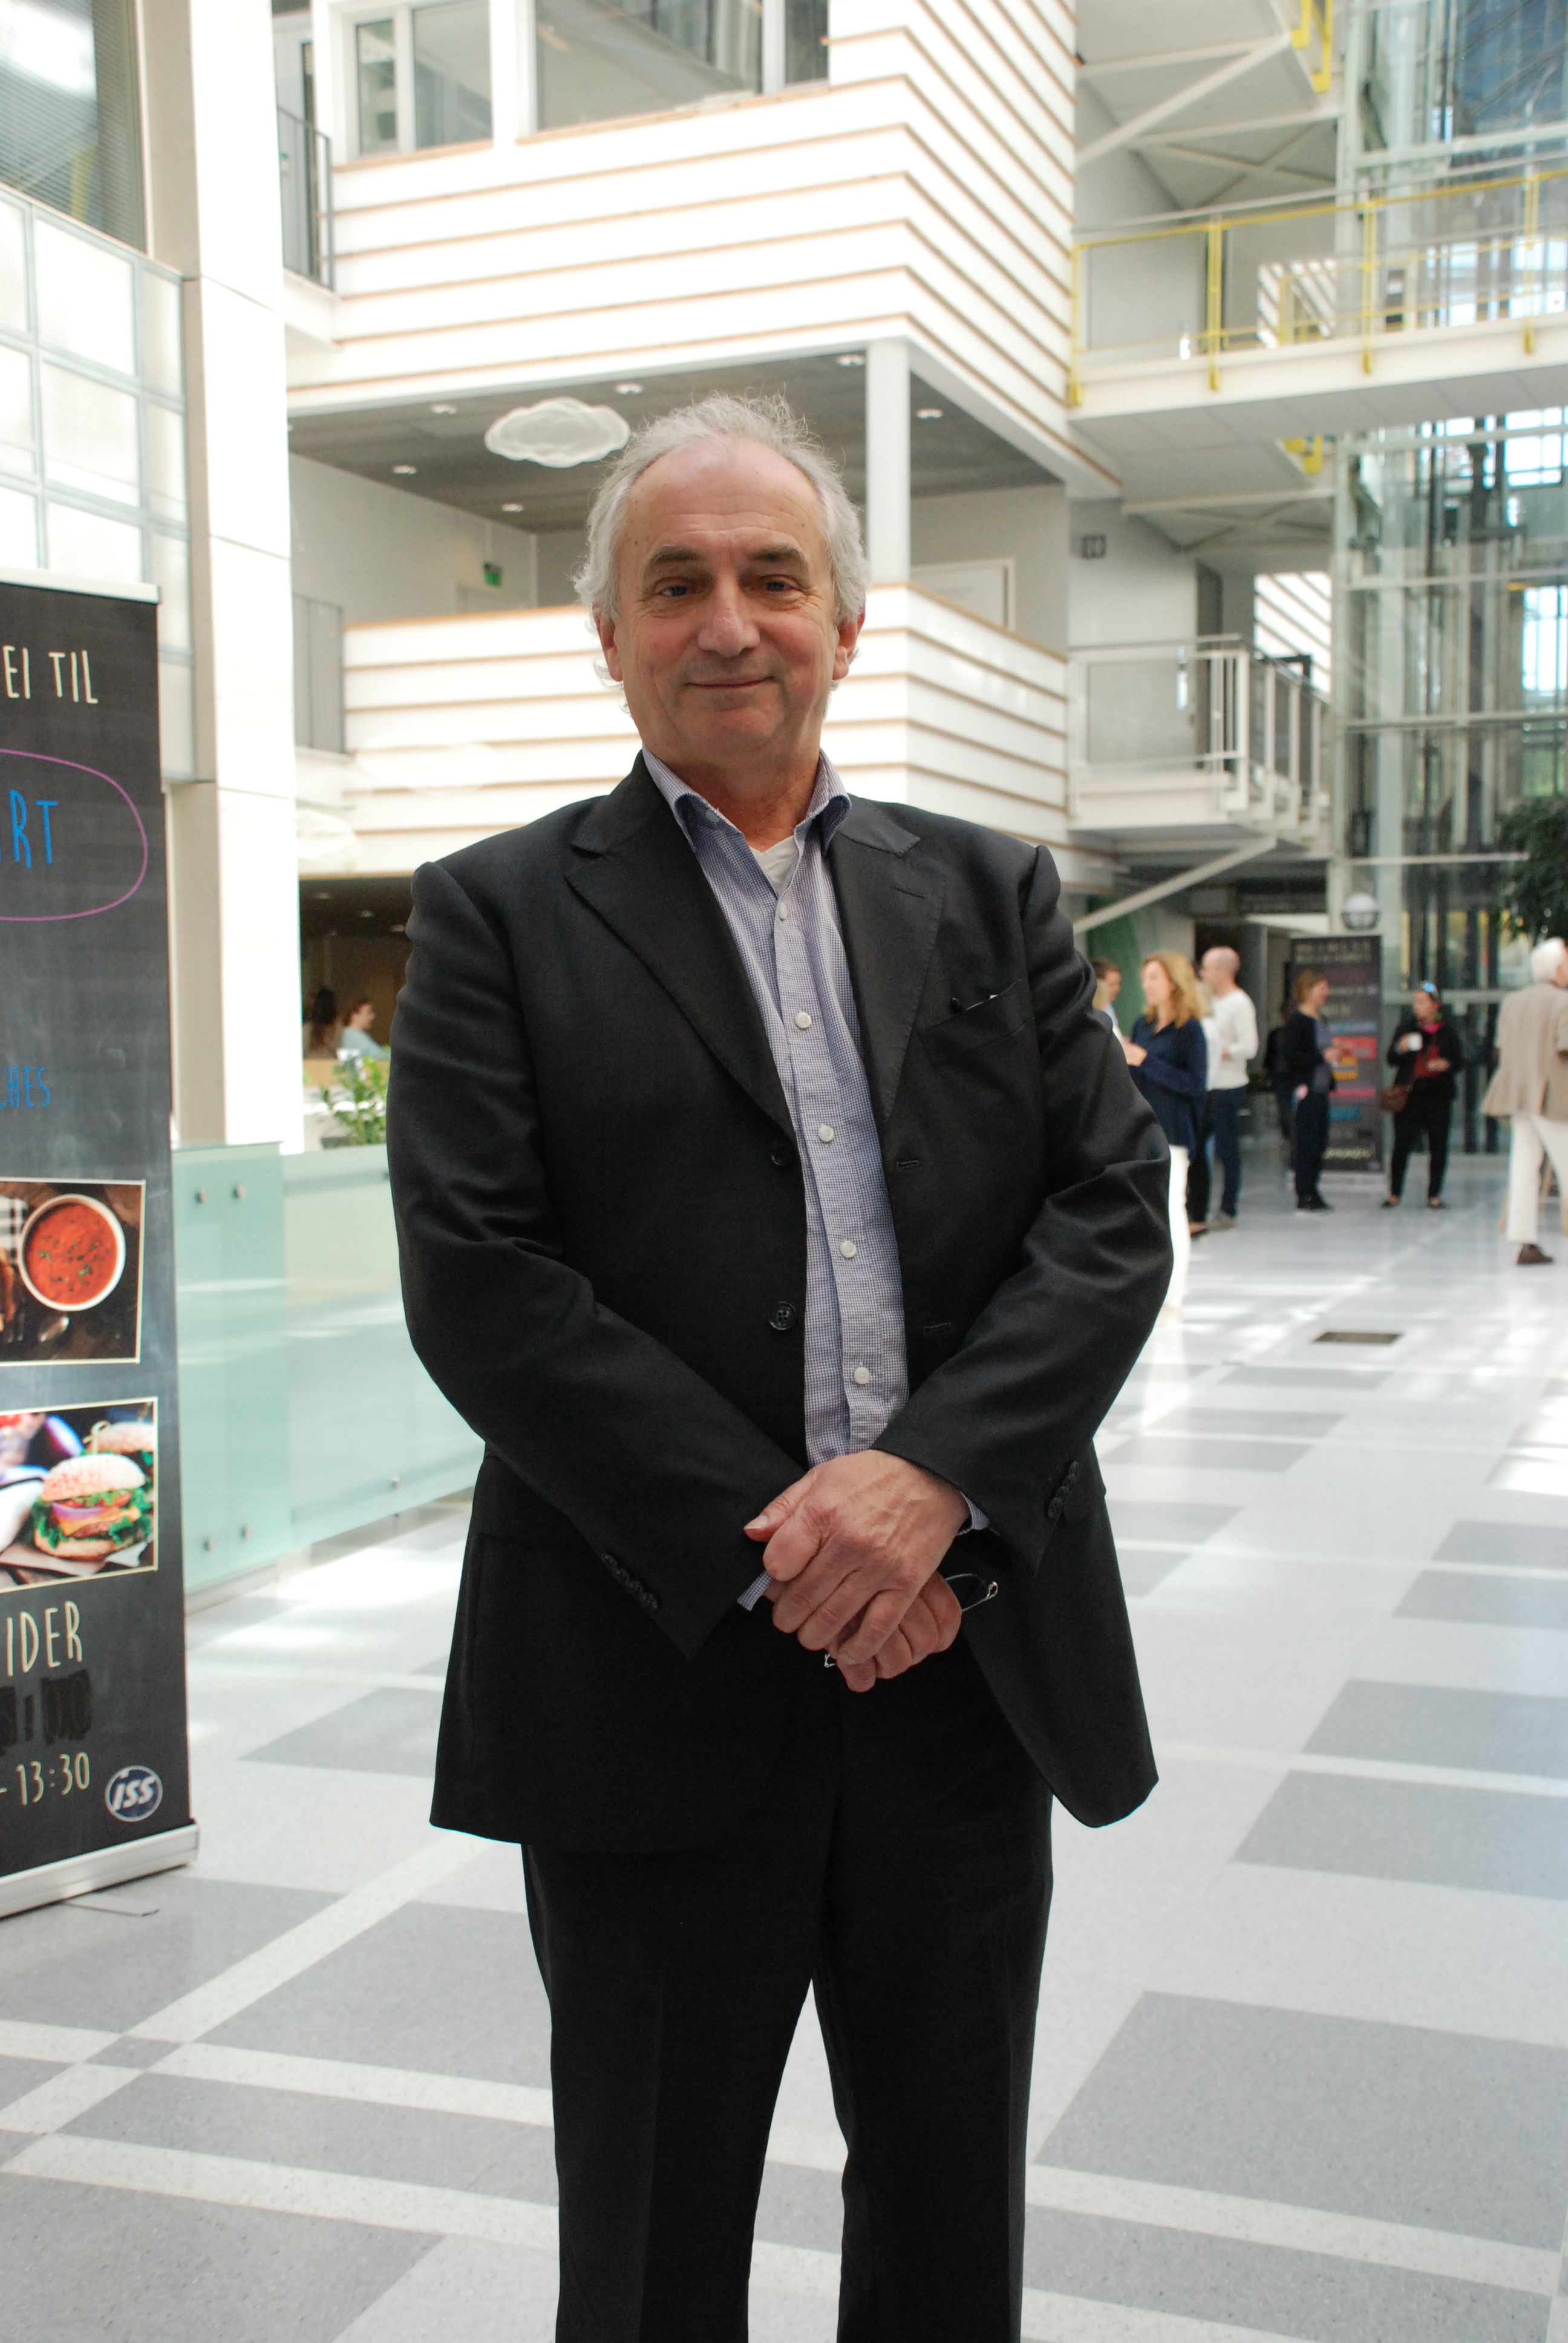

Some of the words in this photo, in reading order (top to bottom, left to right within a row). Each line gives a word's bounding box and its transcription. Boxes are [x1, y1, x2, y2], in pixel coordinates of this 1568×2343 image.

[48, 649, 99, 704] TIL
[0, 788, 59, 868] RT
[0, 1064, 51, 1109] HES
[6, 1600, 83, 1677] IDER
